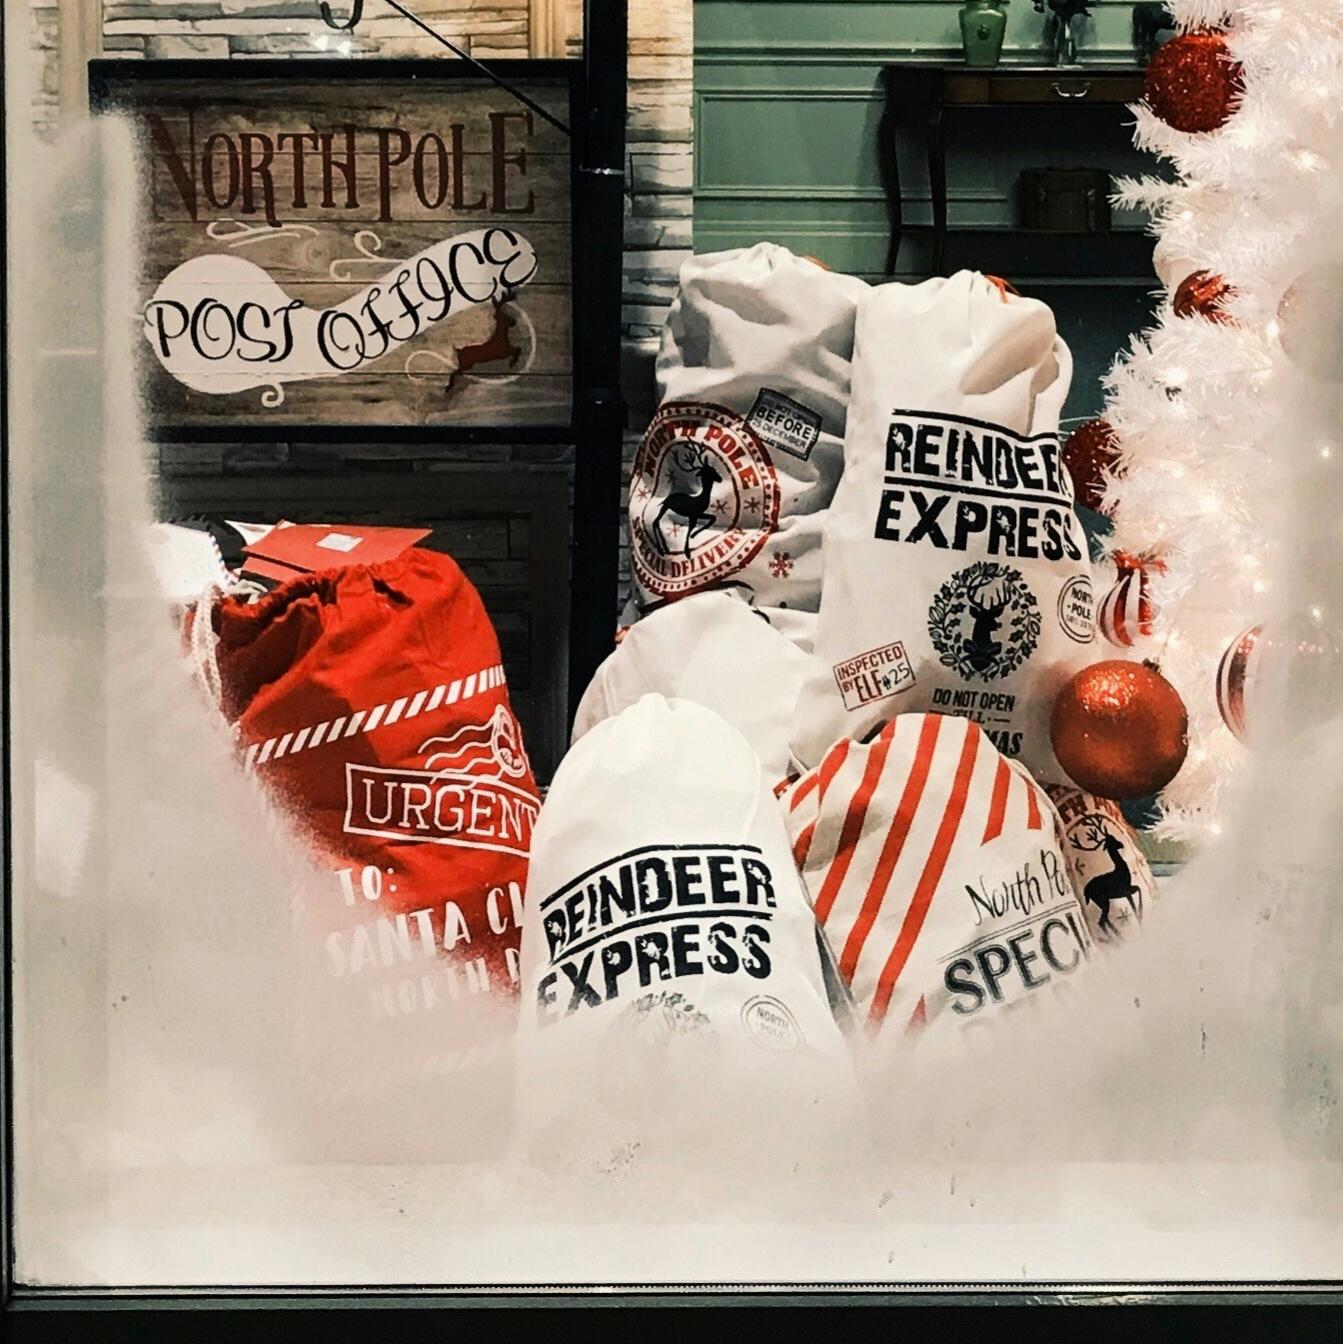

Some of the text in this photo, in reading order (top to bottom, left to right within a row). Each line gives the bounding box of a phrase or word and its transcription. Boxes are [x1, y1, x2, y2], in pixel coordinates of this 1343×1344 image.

[146, 105, 536, 227] NORTH POLE
[144, 227, 538, 370] POST OFFICE
[756, 406, 812, 440] BEFORE
[704, 424, 760, 490] POLE
[885, 422, 1073, 499] REINDEER
[671, 527, 747, 578] DELIVERY
[874, 489, 1082, 561] EXPRESS
[837, 645, 903, 680] INSPECTED
[842, 662, 911, 702] BY ELF #25
[932, 688, 1016, 712] DO NOT OPEN
[362, 777, 539, 842] URGENT
[543, 856, 777, 955] REINDEER
[964, 862, 1045, 927] North
[325, 901, 472, 977] SANTA
[537, 922, 772, 1030] EXPRESS
